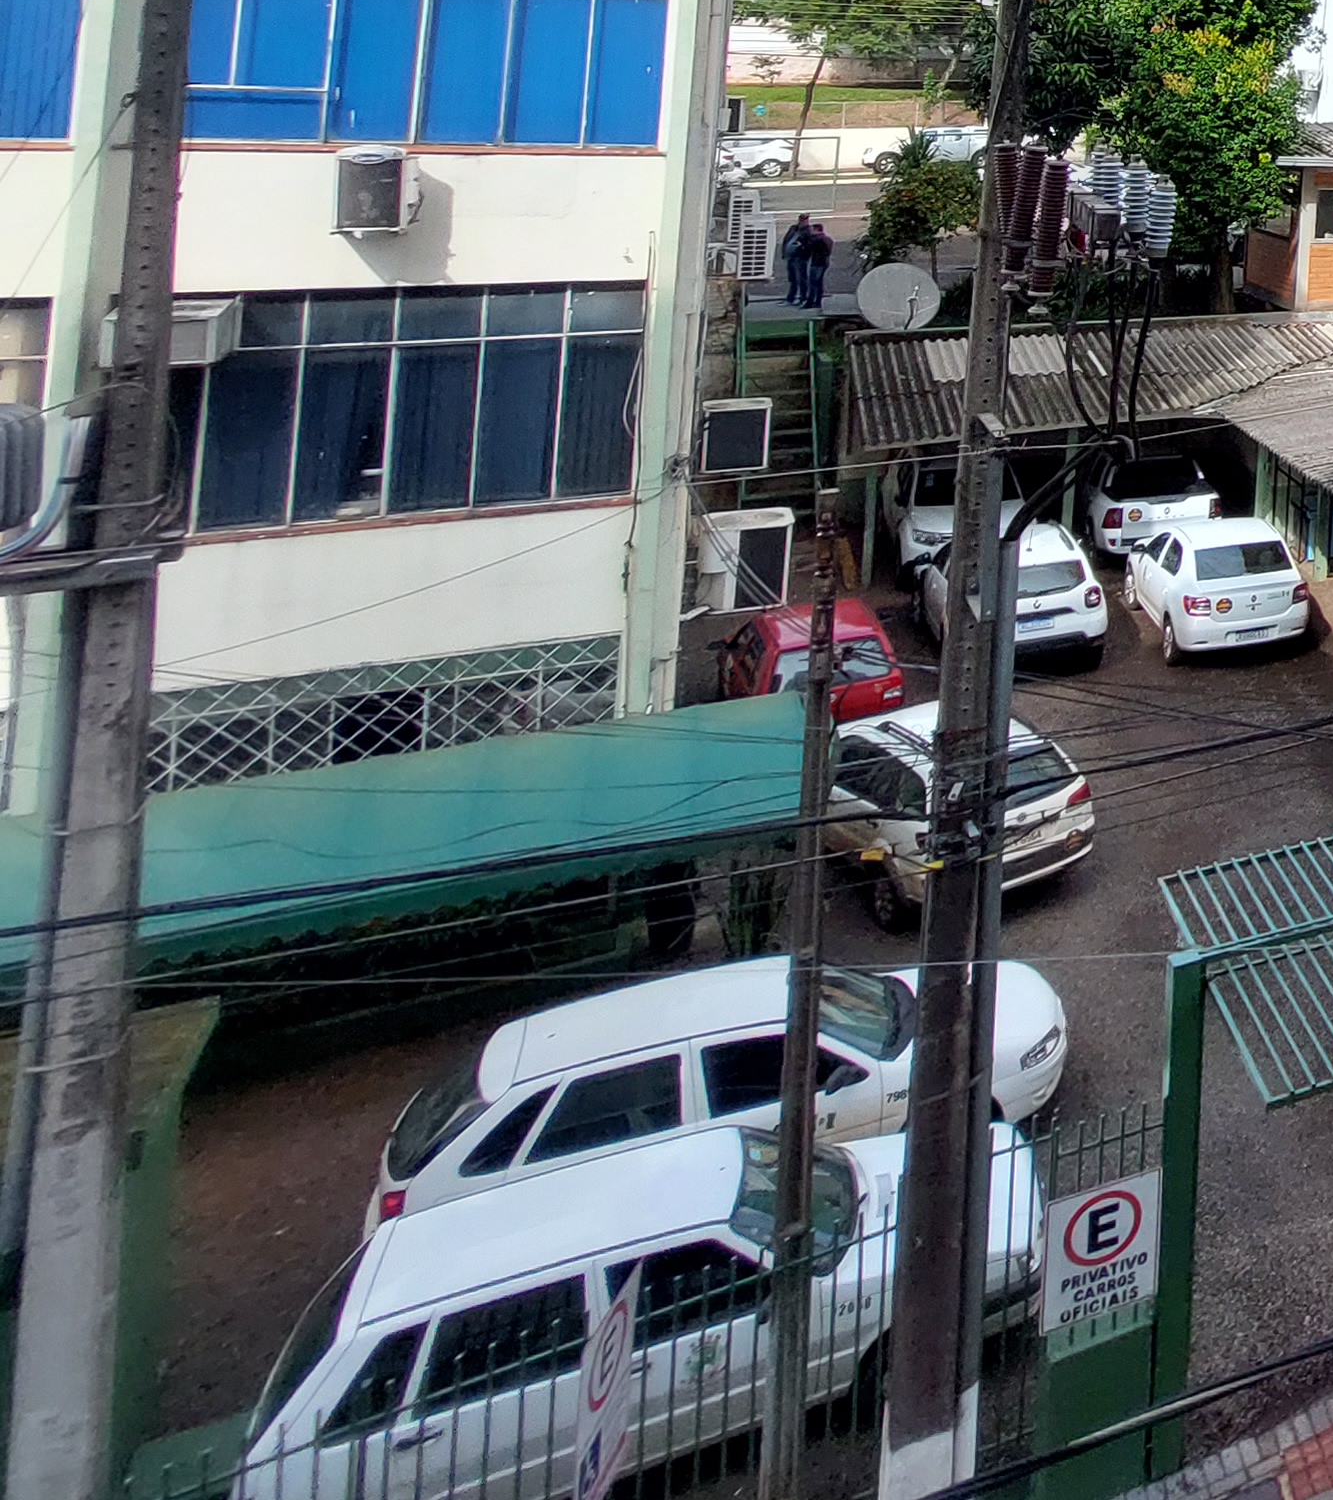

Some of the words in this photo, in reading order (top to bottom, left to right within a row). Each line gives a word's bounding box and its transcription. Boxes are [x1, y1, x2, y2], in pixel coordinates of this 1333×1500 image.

[1086, 1201, 1121, 1255] E
[1061, 1251, 1148, 1293] PRIVATIVO
[1073, 1271, 1136, 1302] CARROS
[1060, 1285, 1139, 1323] OFICIAIS
[599, 1323, 618, 1388] E
